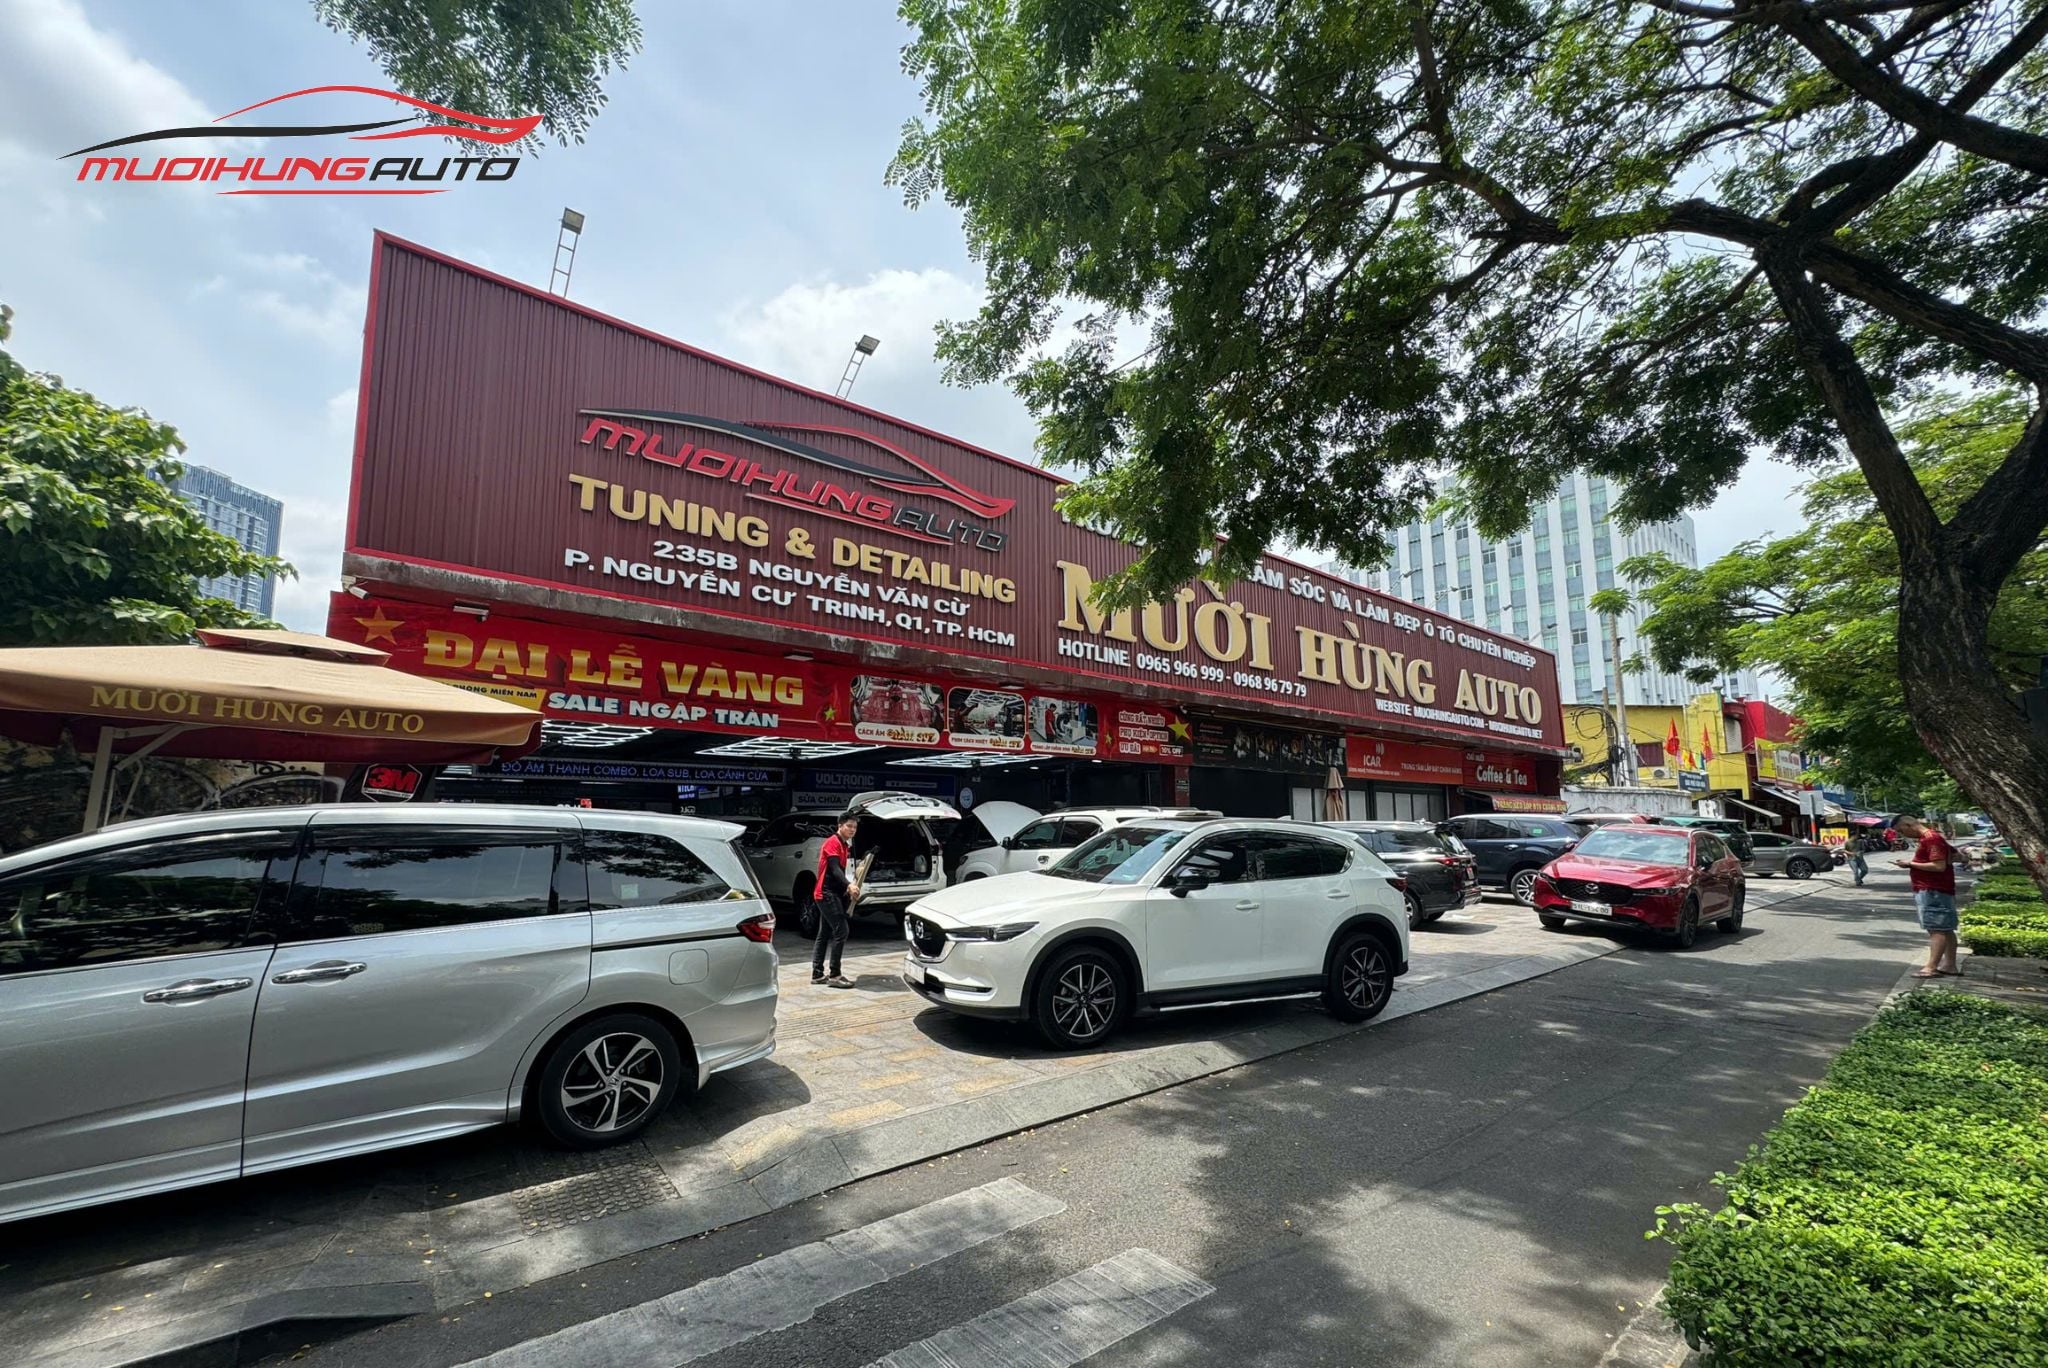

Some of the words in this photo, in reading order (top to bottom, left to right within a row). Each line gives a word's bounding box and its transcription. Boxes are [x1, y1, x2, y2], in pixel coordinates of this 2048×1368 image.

[569, 474, 770, 547] TUNING
[786, 527, 816, 560] &
[833, 538, 1016, 603] DETAILING
[565, 548, 595, 571] P.
[603, 556, 741, 598] NGUYỄN
[751, 584, 797, 607] CƯ
[968, 626, 1016, 647] HCM
[653, 540, 739, 571] 235B
[749, 559, 870, 598] NGUYỄN
[876, 585, 930, 610] VĂN
[934, 596, 971, 617] CỪ
[1056, 560, 1275, 672] MƯỜI
[1295, 620, 1437, 704] HÙNG
[1454, 669, 1543, 725] AUTO
[1288, 575, 1326, 604] SÓC
[1330, 588, 1353, 613] VÀ
[1355, 598, 1390, 624] LÀM
[1393, 611, 1421, 635] ĐẸP
[1423, 618, 1435, 638] Ô
[1437, 625, 1456, 645] TÔ
[1457, 632, 1502, 658] CHUYÊN
[1503, 647, 1537, 672] NGHIỆP
[423, 629, 549, 680] ĐẠI
[568, 643, 644, 689] LỄ
[660, 661, 804, 706] VÀNG
[1136, 652, 1171, 674] 0965
[1173, 659, 1198, 679] 966
[1200, 664, 1225, 683] 999
[1233, 671, 1263, 691] 0968
[1264, 677, 1278, 693] 96
[1279, 679, 1293, 696] 79
[1294, 682, 1308, 698] 79
[516, 690, 538, 699] NAM
[547, 691, 621, 715] SALE
[628, 699, 706, 724] NGẬP
[714, 704, 780, 729] TRÀN
[333, 708, 425, 734] AUTO
[368, 767, 418, 793] 3M
[525, 762, 545, 774] ÂM
[548, 763, 591, 775] THANH
[642, 767, 666, 778] LOA
[695, 769, 716, 780] LOA
[815, 772, 875, 786] VOLTRONIC
[1363, 754, 1382, 768] ICAR
[1476, 764, 1504, 783] Coffee
[1505, 768, 1512, 784] &
[1513, 769, 1528, 786] Tea
